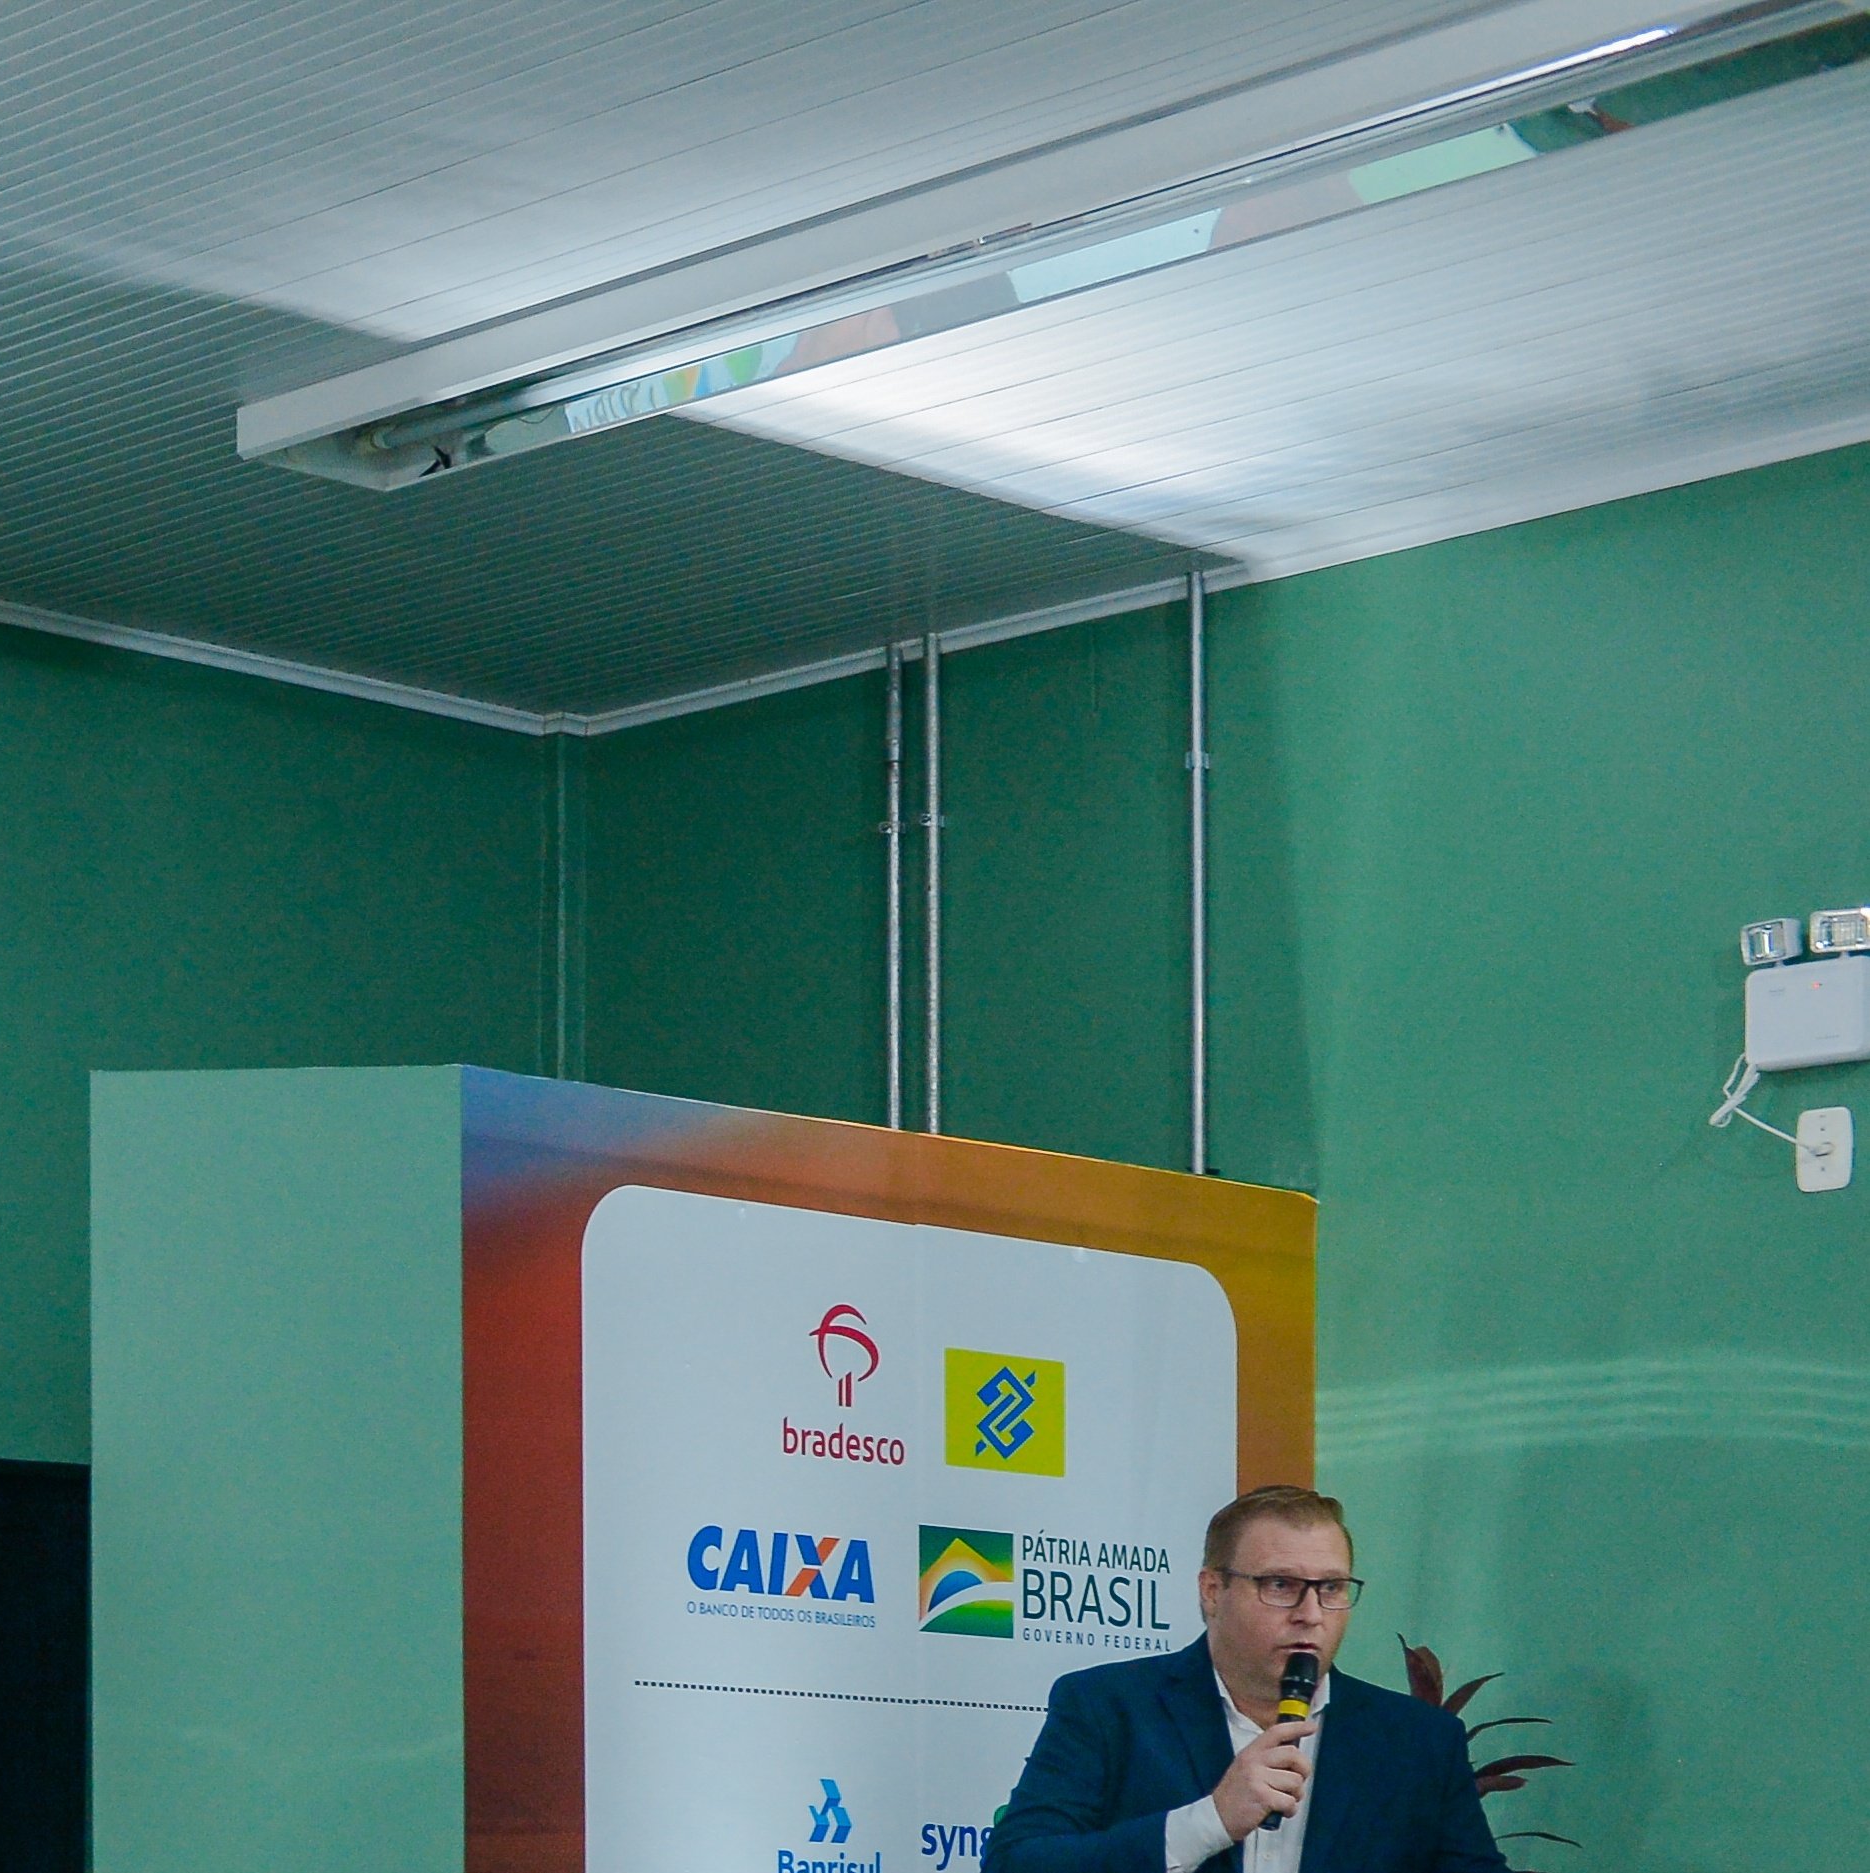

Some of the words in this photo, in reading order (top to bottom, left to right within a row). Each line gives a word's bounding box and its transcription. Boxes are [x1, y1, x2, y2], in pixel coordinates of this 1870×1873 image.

[783, 1416, 904, 1465] bradesco
[687, 1525, 875, 1604] CAIXA
[1022, 1529, 1091, 1567] PÁTRIA
[1097, 1543, 1170, 1574] AMADA
[687, 1601, 696, 1614] O
[699, 1602, 737, 1617] BANCO
[742, 1605, 755, 1619] DE
[759, 1607, 794, 1622] TODOS
[798, 1610, 812, 1623] OS
[815, 1611, 876, 1628] BRASILEIROS
[1023, 1568, 1170, 1630] BRASIL
[1023, 1628, 1095, 1646] GOVERNO
[1104, 1635, 1171, 1652] FEDERAL
